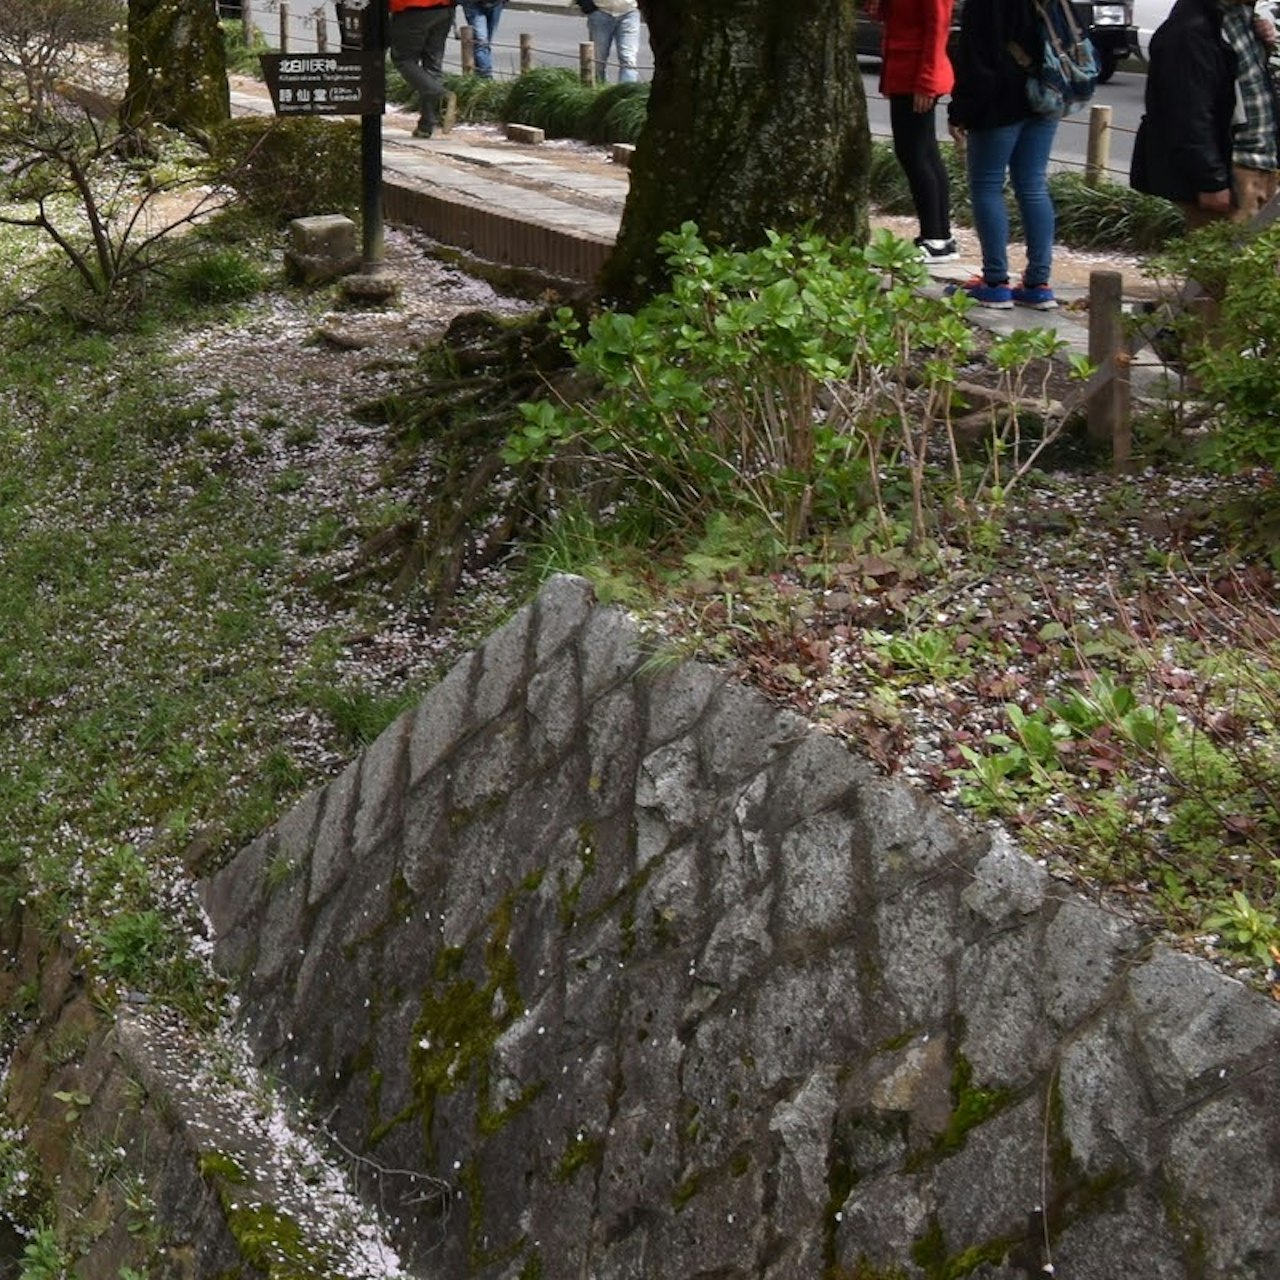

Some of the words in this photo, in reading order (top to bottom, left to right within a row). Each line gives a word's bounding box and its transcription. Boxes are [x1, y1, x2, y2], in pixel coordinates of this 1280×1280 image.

[279, 59, 337, 73] 北白川天神
